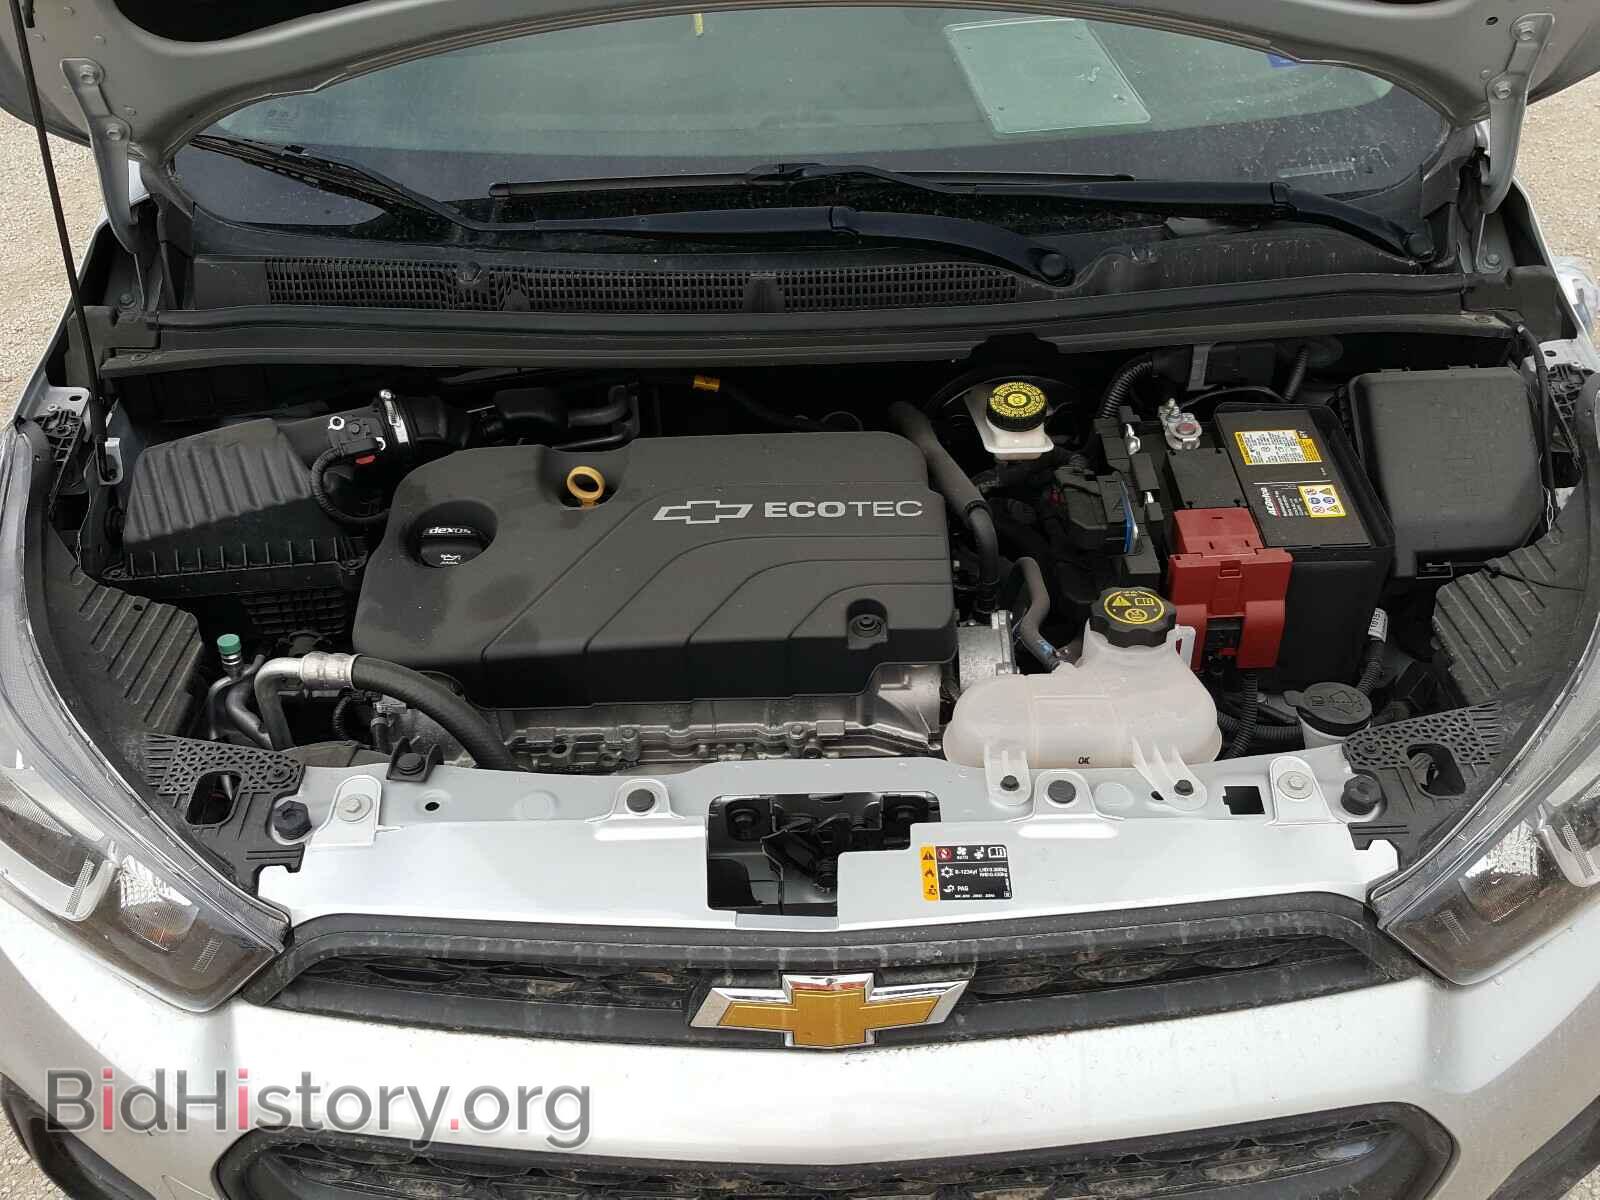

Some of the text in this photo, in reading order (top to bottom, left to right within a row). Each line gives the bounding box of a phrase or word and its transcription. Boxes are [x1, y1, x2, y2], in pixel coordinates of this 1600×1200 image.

[764, 500, 923, 518] ECOTEC
[428, 526, 472, 534] dexos
[1078, 756, 1091, 765] OK
